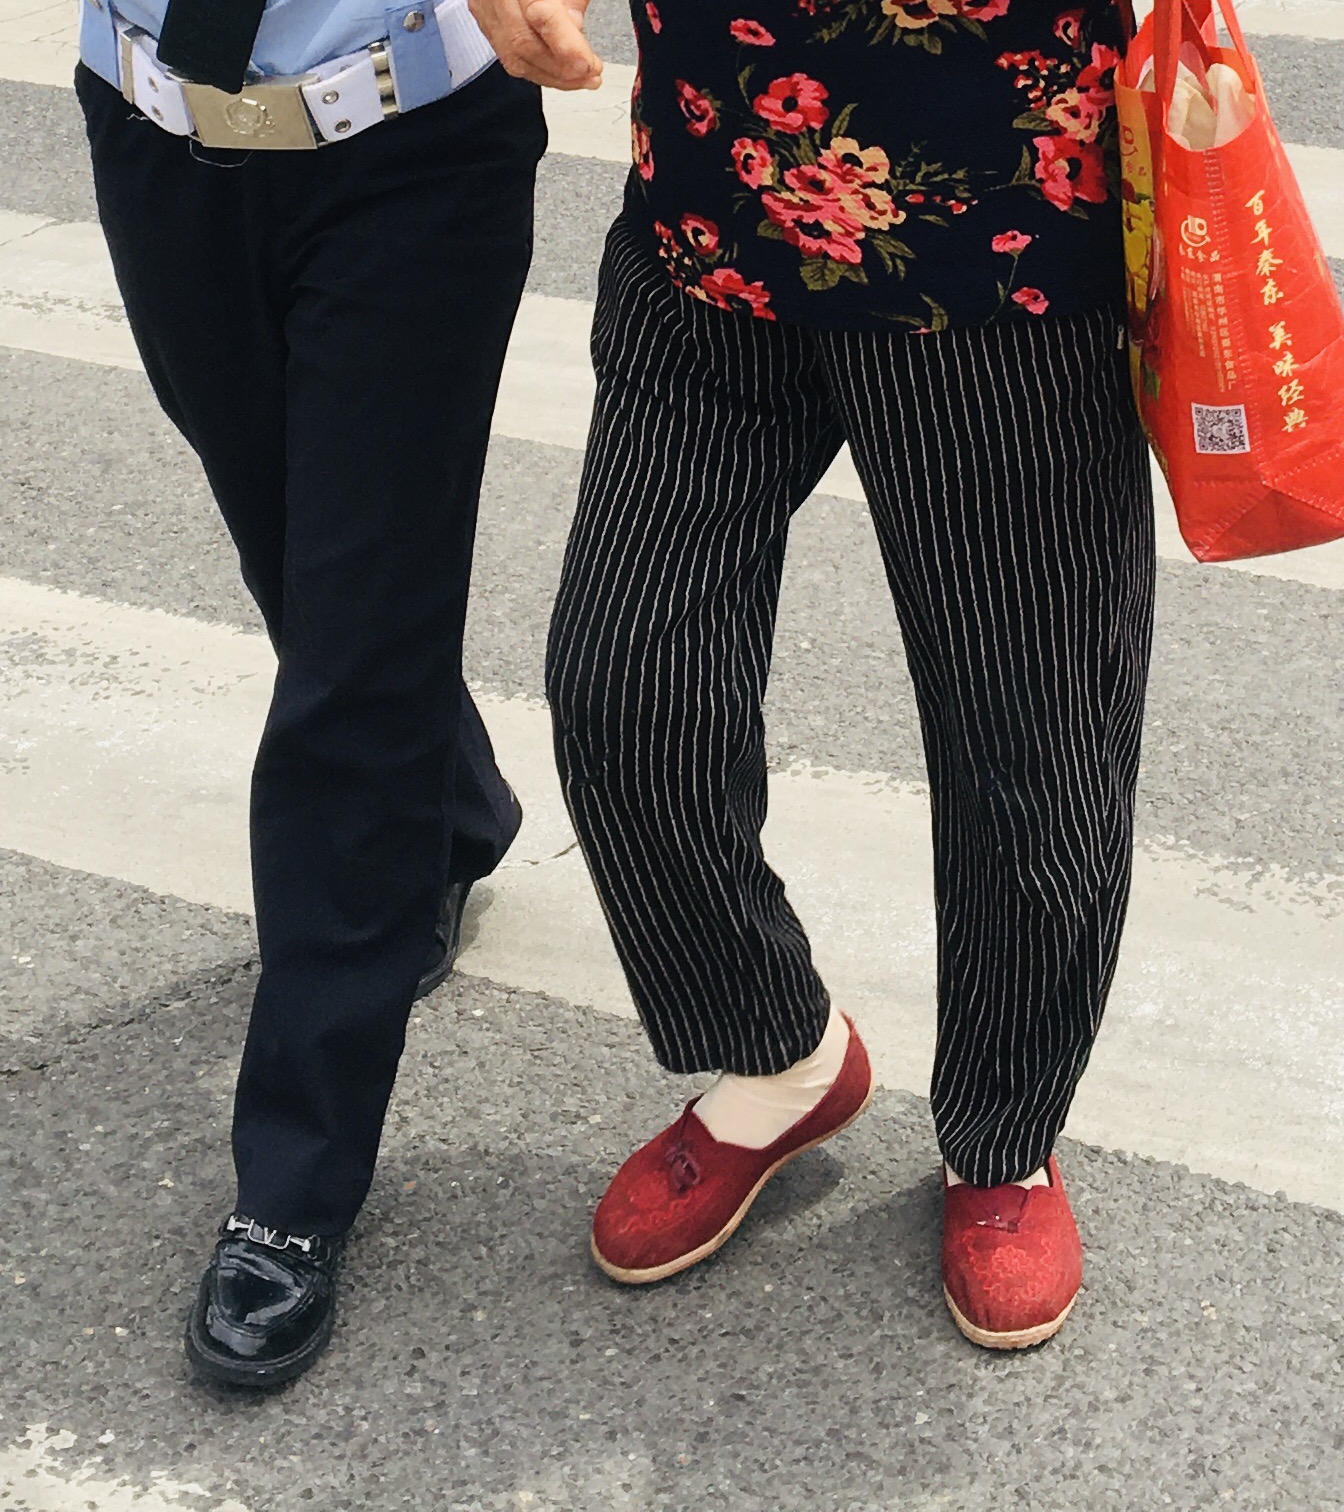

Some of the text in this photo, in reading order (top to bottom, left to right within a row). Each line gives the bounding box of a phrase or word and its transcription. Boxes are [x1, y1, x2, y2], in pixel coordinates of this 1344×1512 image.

[1245, 189, 1311, 434] 百年秦东 美味经典
